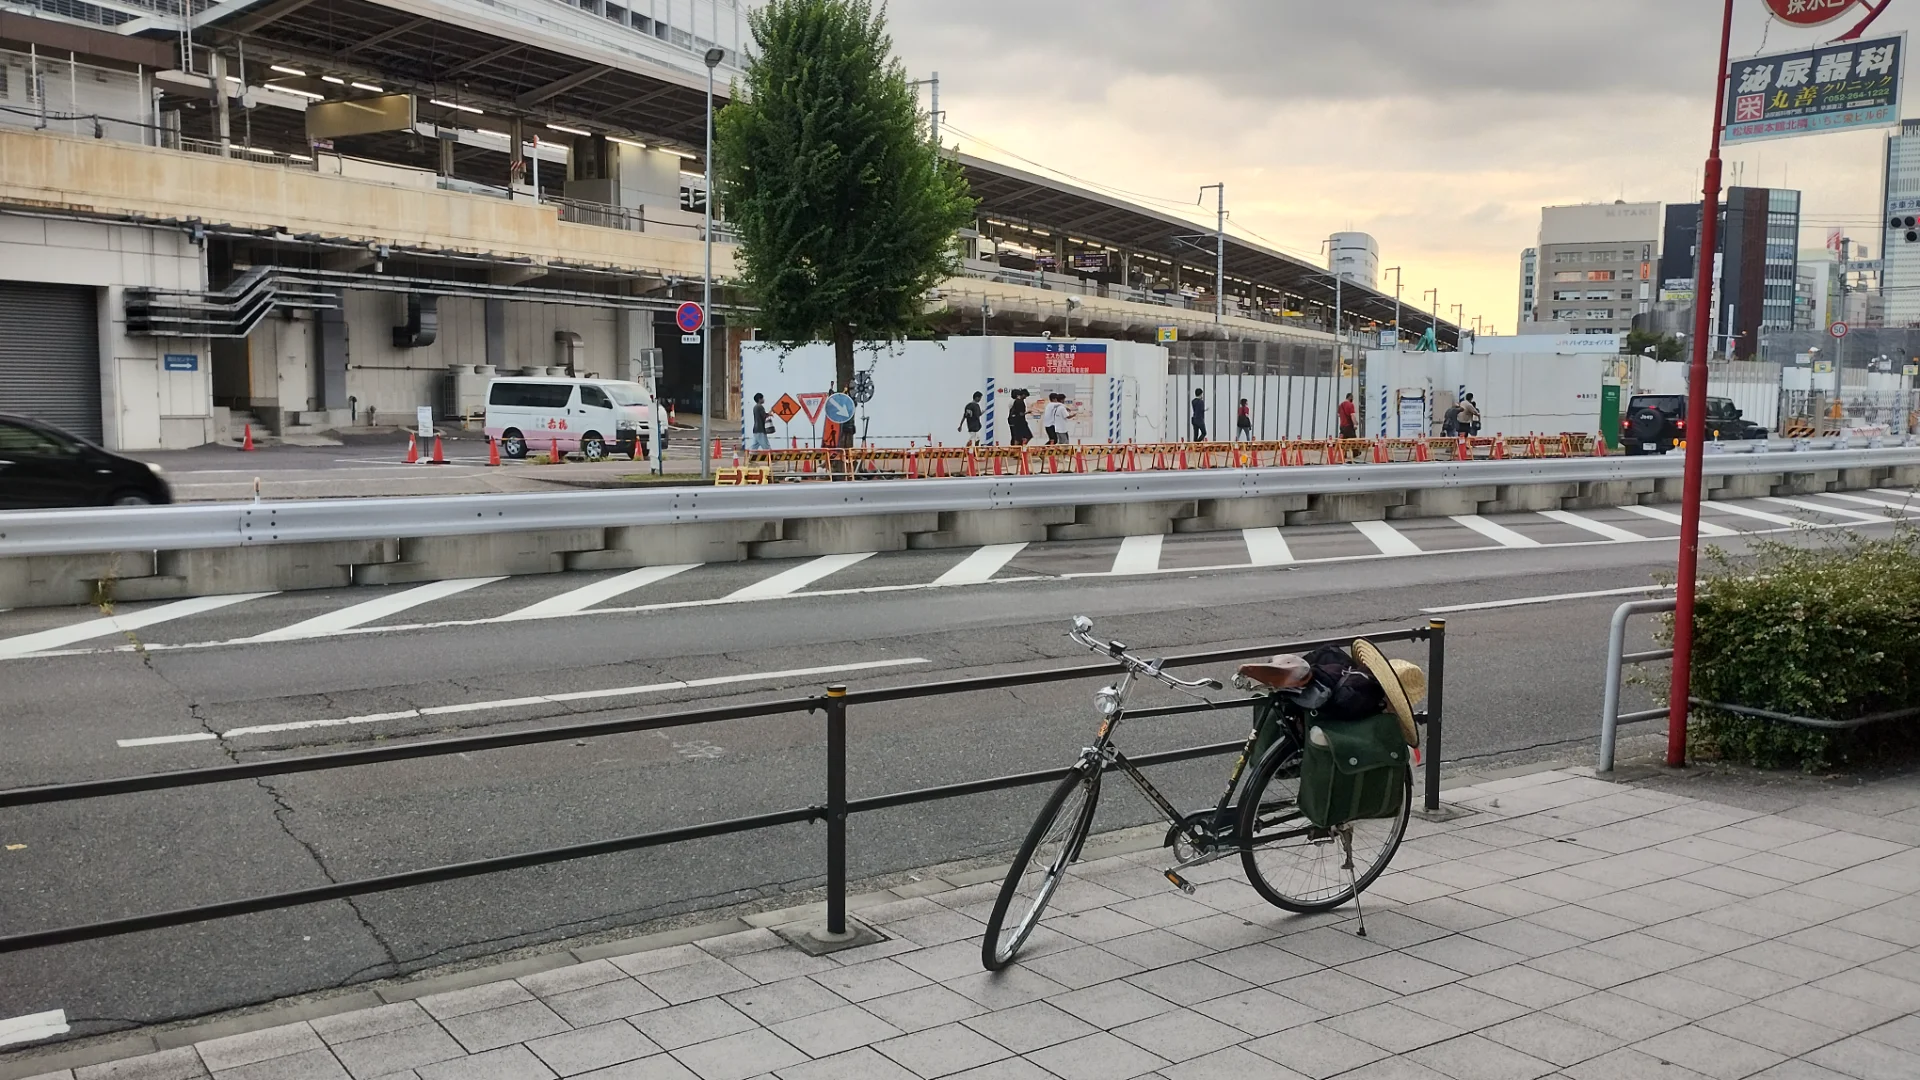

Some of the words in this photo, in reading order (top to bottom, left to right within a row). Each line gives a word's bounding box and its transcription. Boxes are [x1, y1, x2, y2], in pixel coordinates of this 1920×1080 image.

[1737, 44, 1895, 94] 泌尿器科
[1738, 96, 1761, 119] 栄
[1606, 208, 1652, 217] MITANI
